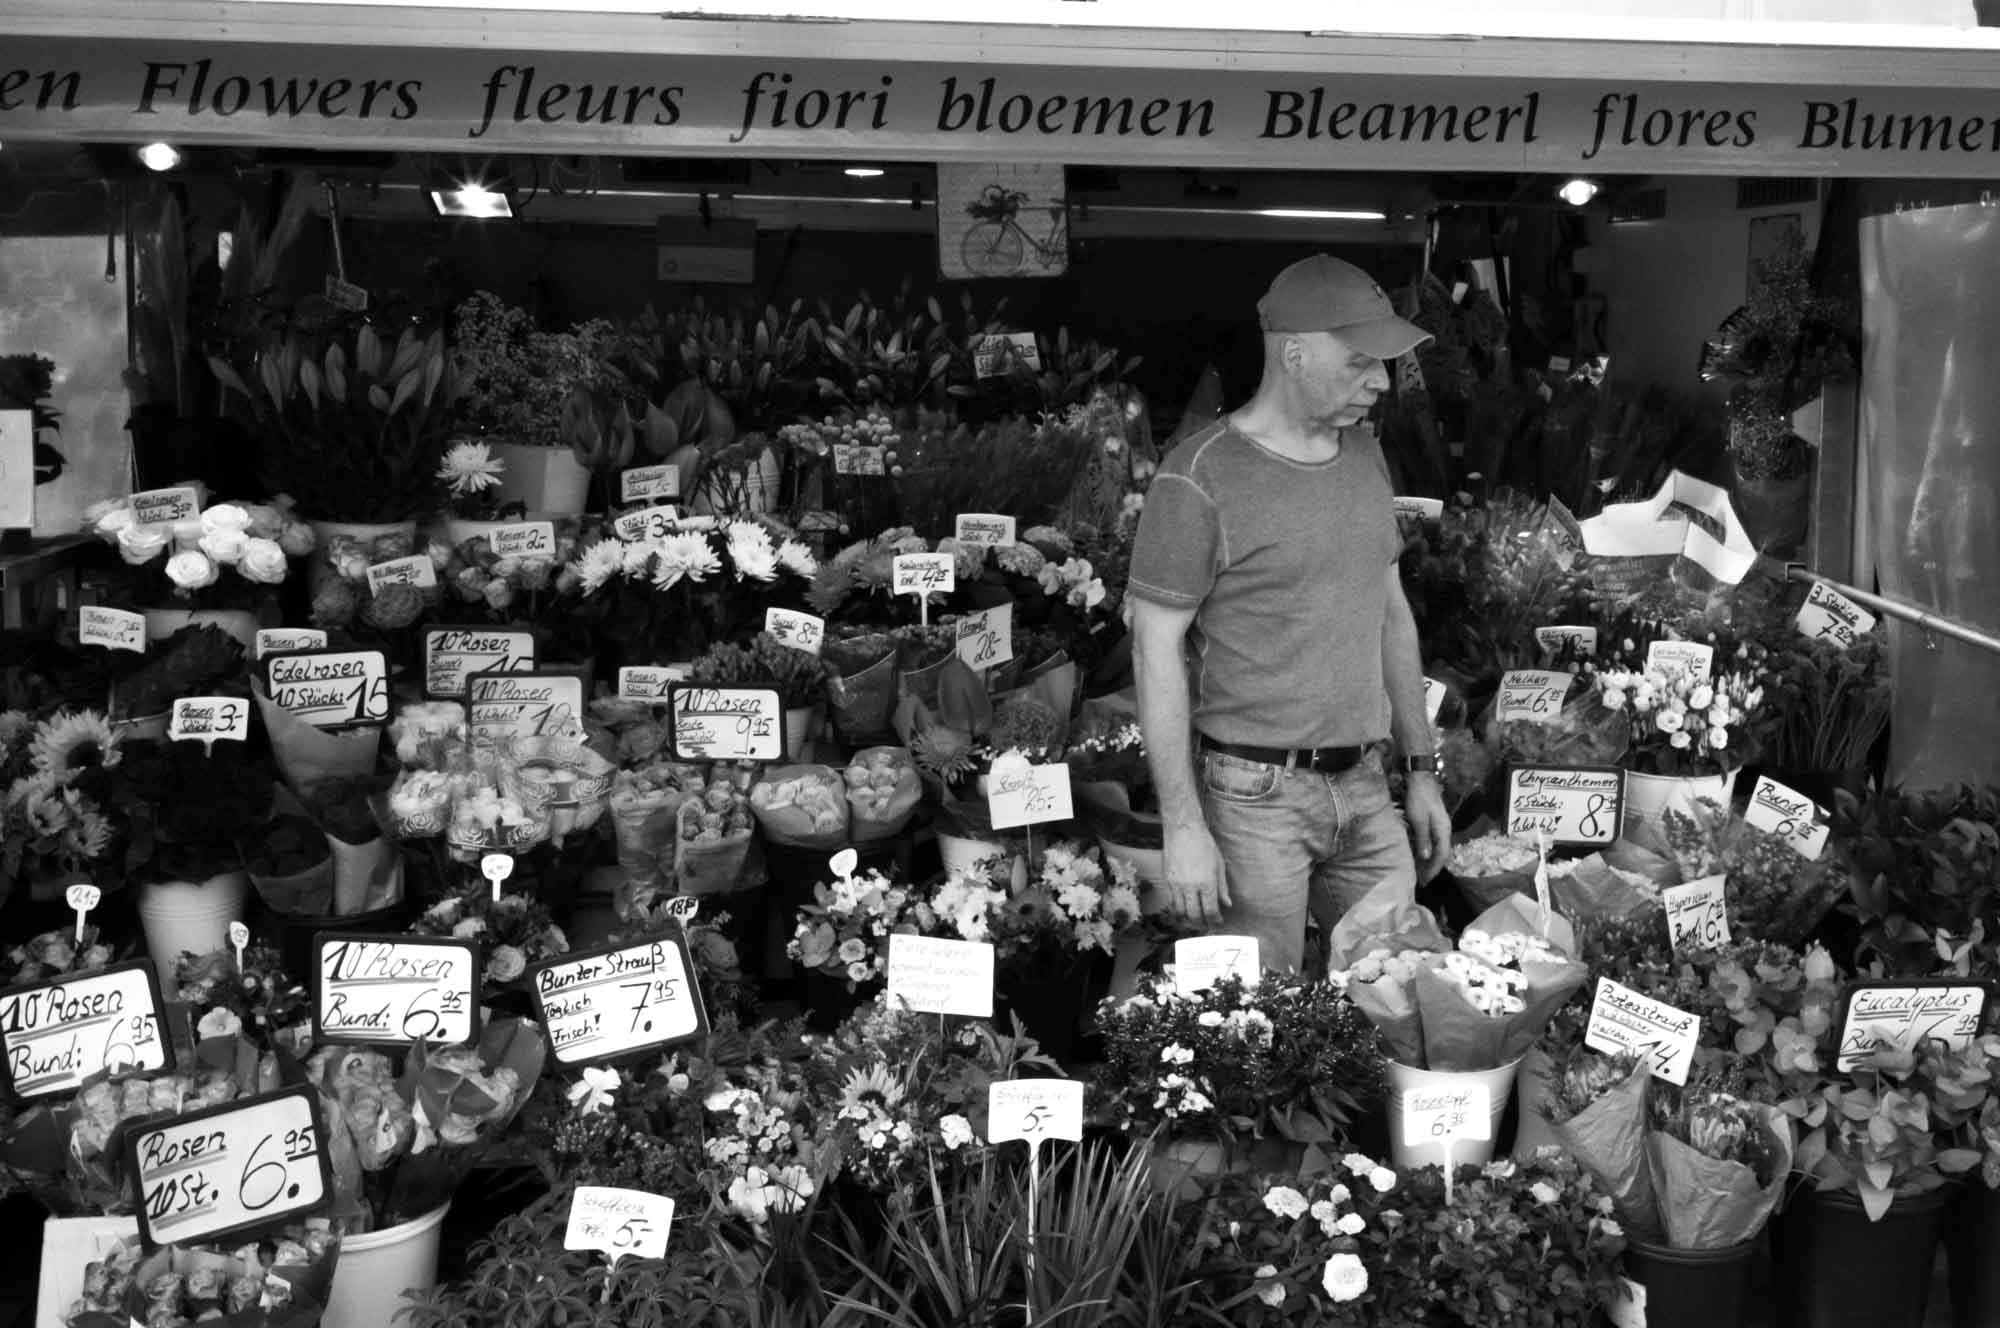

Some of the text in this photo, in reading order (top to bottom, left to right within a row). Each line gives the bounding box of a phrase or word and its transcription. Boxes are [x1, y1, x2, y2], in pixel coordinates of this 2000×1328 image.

[132, 59, 423, 120] Flowers
[469, 65, 685, 137] fleurs
[729, 72, 893, 143] fiori
[937, 77, 1215, 137] bloemen
[1258, 86, 1541, 143] Bleamerl
[1581, 92, 1757, 159] flores
[458, 631, 510, 652] Rosen
[499, 680, 552, 700] Rosen
[705, 688, 761, 712] Rosen
[364, 943, 453, 979] Rosen
[540, 942, 666, 993] Bunter Strauß
[46, 986, 124, 1023] Rosen
[322, 992, 390, 1028] Bund:
[1854, 988, 1970, 1022] Eucalyptus
[9, 1034, 81, 1081] Bund:
[143, 1132, 226, 1170] Rosen
